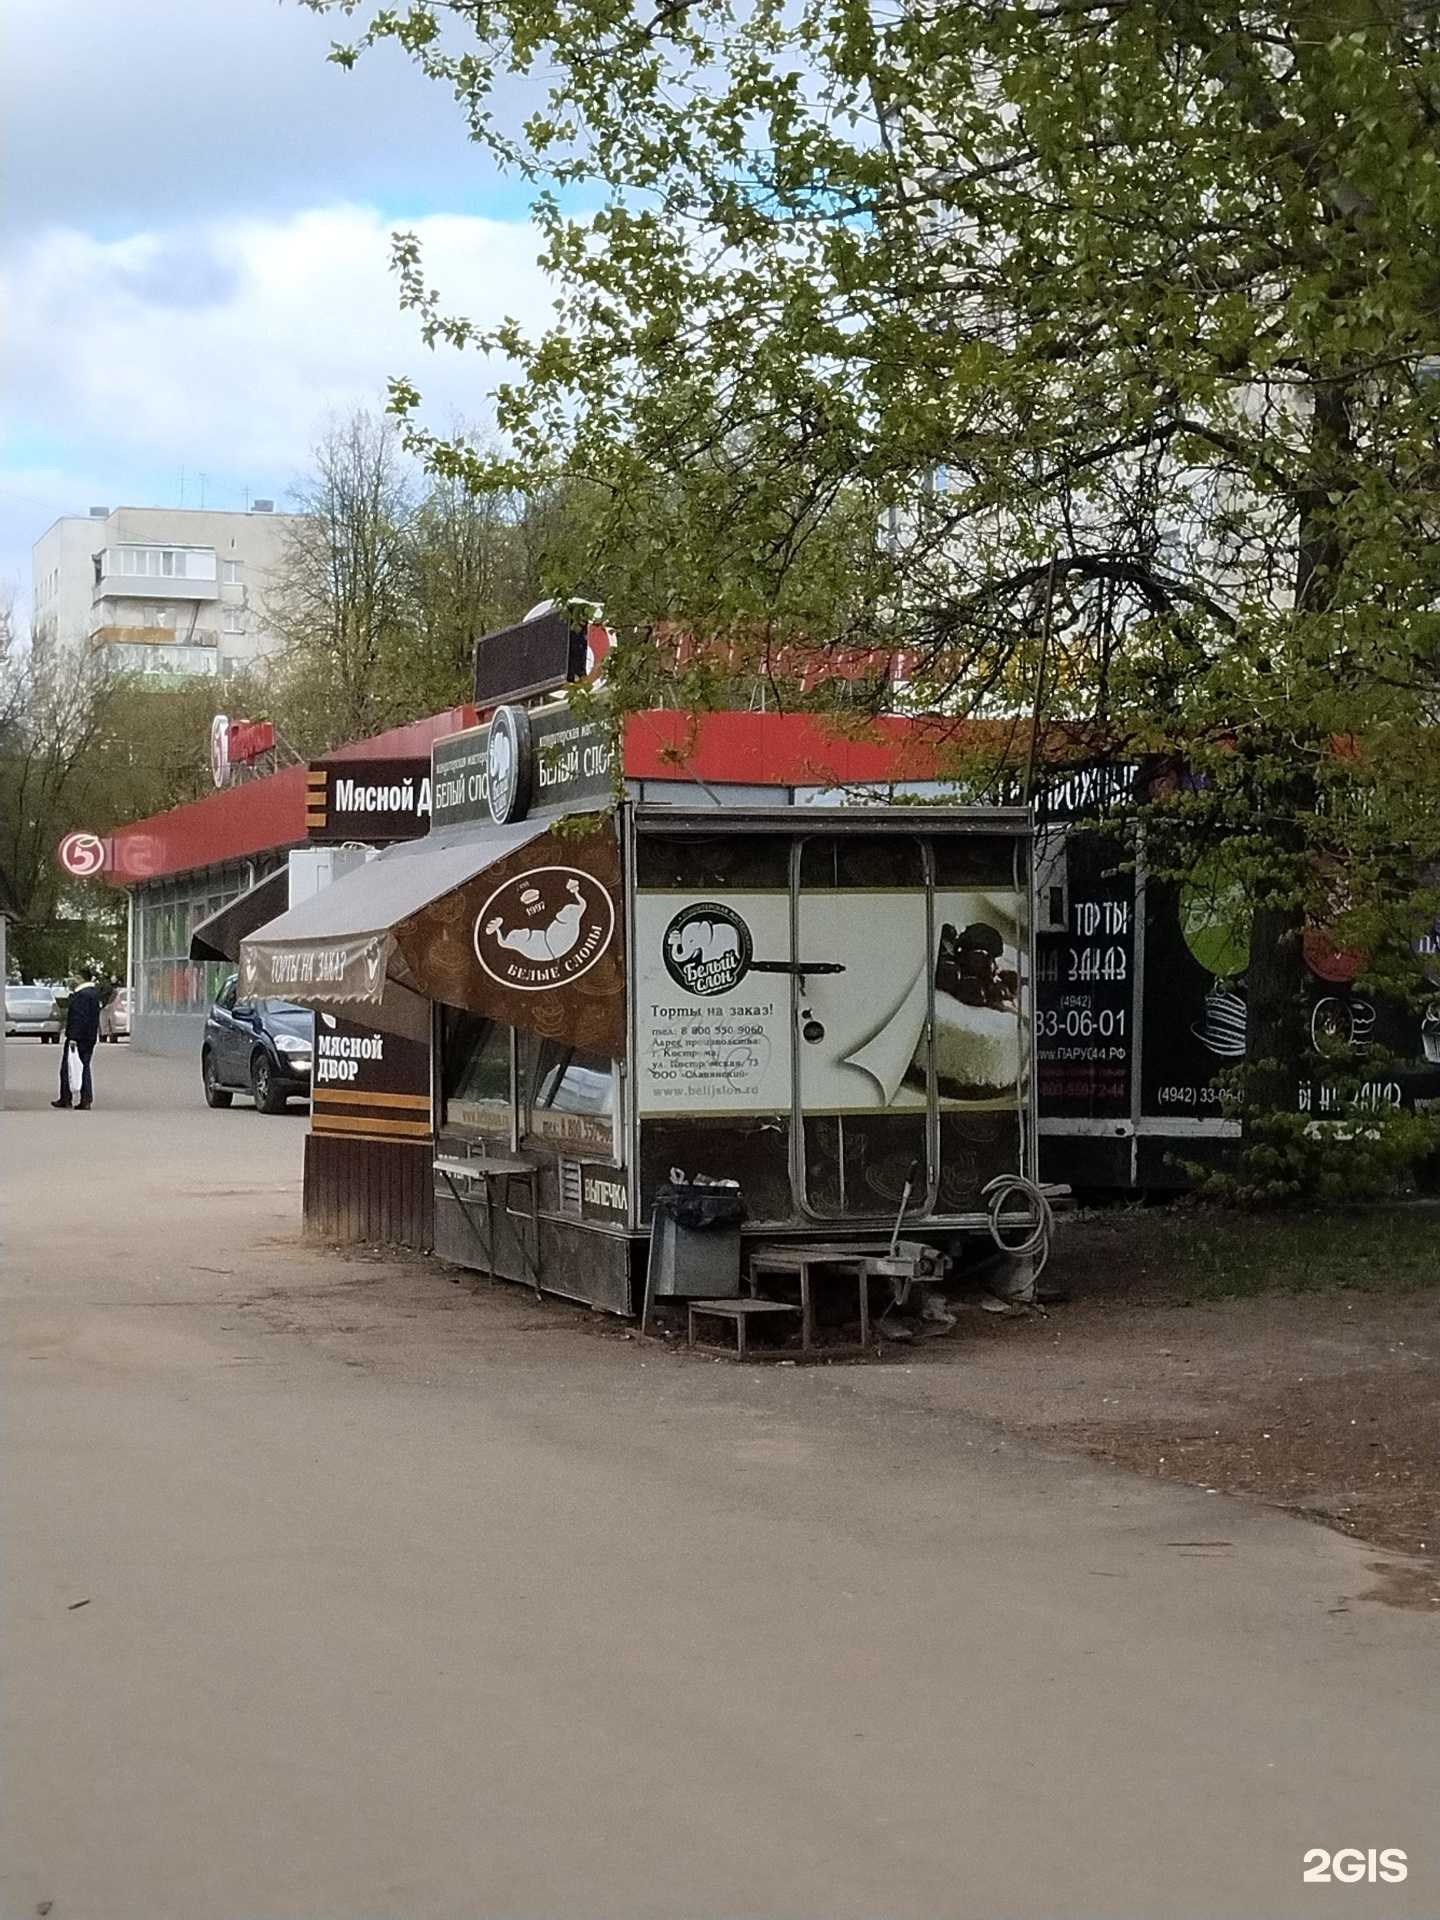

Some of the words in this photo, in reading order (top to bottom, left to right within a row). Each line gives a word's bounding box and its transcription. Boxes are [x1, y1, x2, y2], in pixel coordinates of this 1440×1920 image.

[335, 779, 414, 812] Мясной
[417, 778, 432, 817] Д
[436, 773, 466, 809] БЕЛЫЙ
[468, 773, 489, 802] СЛО
[526, 901, 546, 916] 1997
[507, 964, 561, 982] БЕЛЫЕ
[564, 925, 603, 972] СЛОНЫ
[1068, 946, 1126, 981] ЗАКАЗ
[271, 954, 301, 983] ТОРТЫ
[301, 953, 314, 982] НА
[316, 952, 347, 982] ЗАКАЗ
[683, 952, 737, 982] Белый
[650, 1004, 702, 1020] Торты
[707, 1007, 723, 1017] на
[729, 1003, 774, 1017] заказ!
[1060, 996, 1092, 1009] (4942)
[1036, 1009, 1126, 1036] 33-06-01
[318, 1034, 383, 1060] МЯСНОЙ
[663, 1048, 720, 1058] Кострма,
[317, 1058, 359, 1082] ДВОР
[652, 1070, 678, 1080] ООО
[1158, 1086, 1197, 1104] (4942)
[1200, 1087, 1245, 1104] 33-06-0
